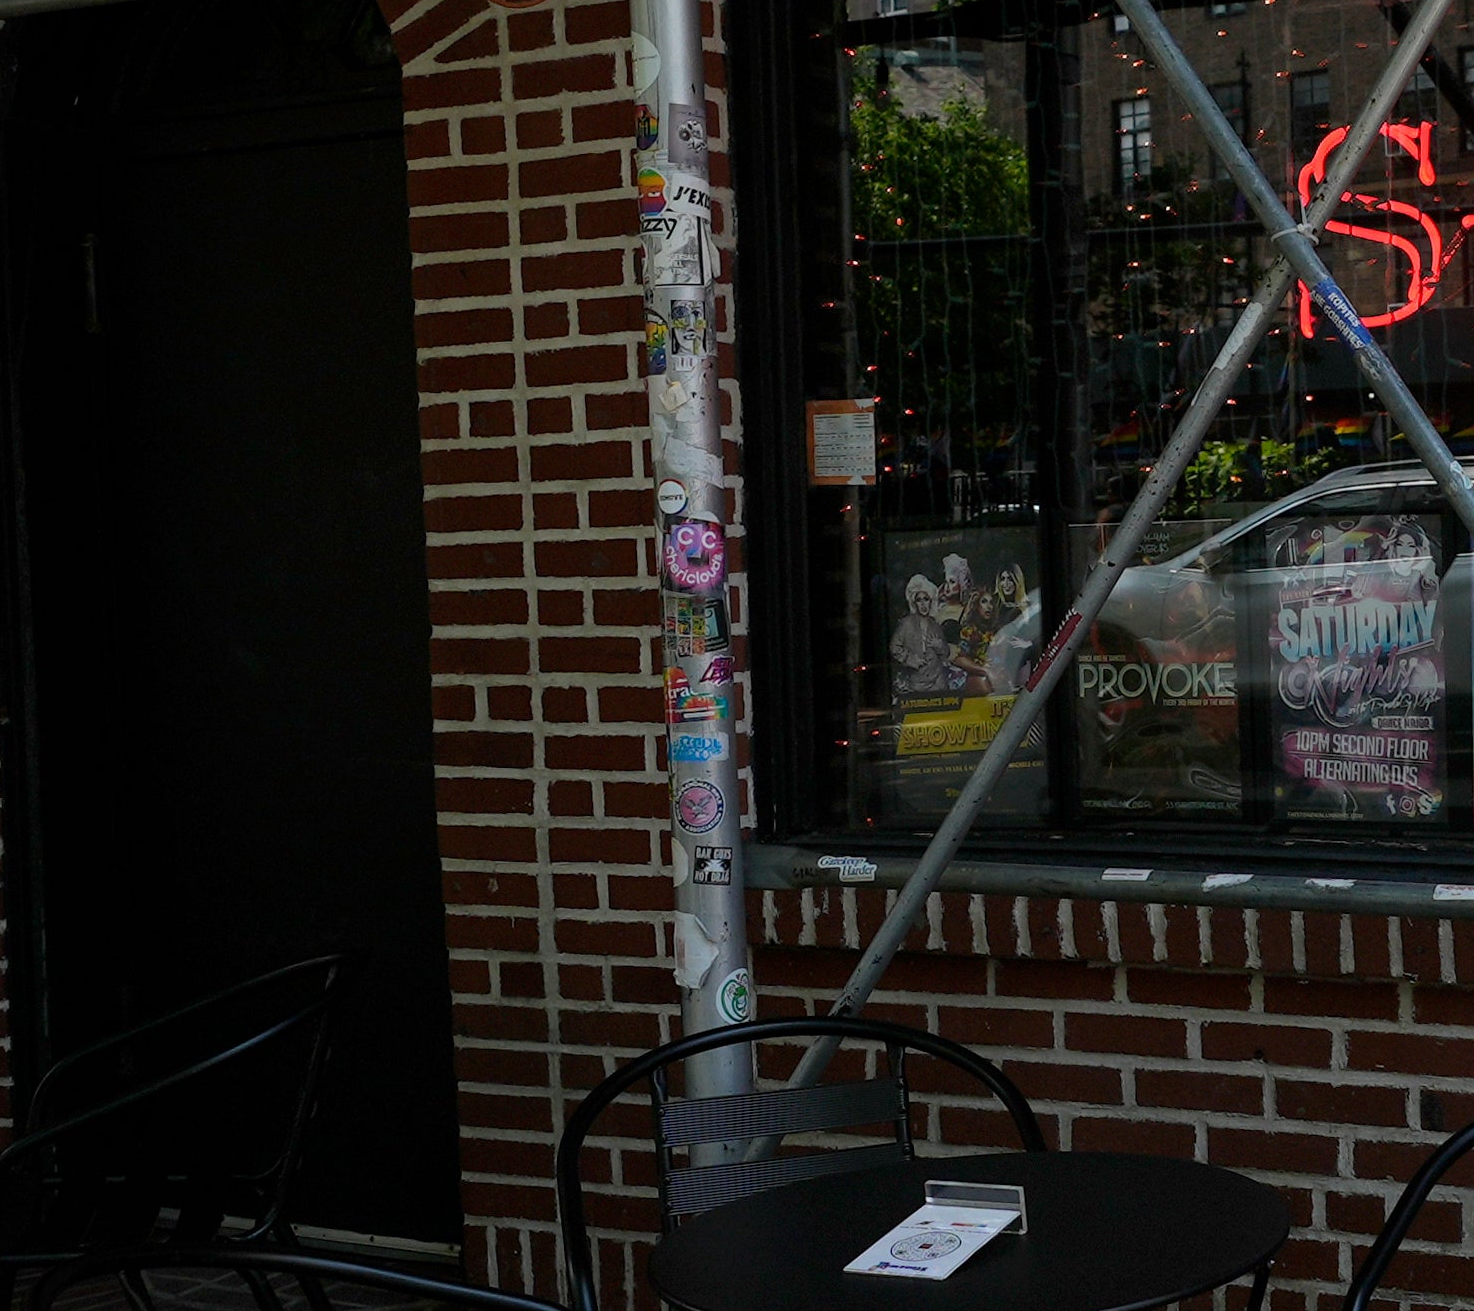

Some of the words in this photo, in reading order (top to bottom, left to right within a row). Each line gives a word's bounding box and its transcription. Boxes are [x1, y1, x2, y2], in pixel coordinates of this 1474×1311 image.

[1278, 599, 1437, 662] SATURDAY
[1078, 663, 1237, 705] PROVOKE
[1295, 731, 1329, 753] 10PM
[1332, 736, 1384, 760] SECOND
[1387, 739, 1429, 760] FLOOR
[1304, 758, 1390, 785] ALTERNATING
